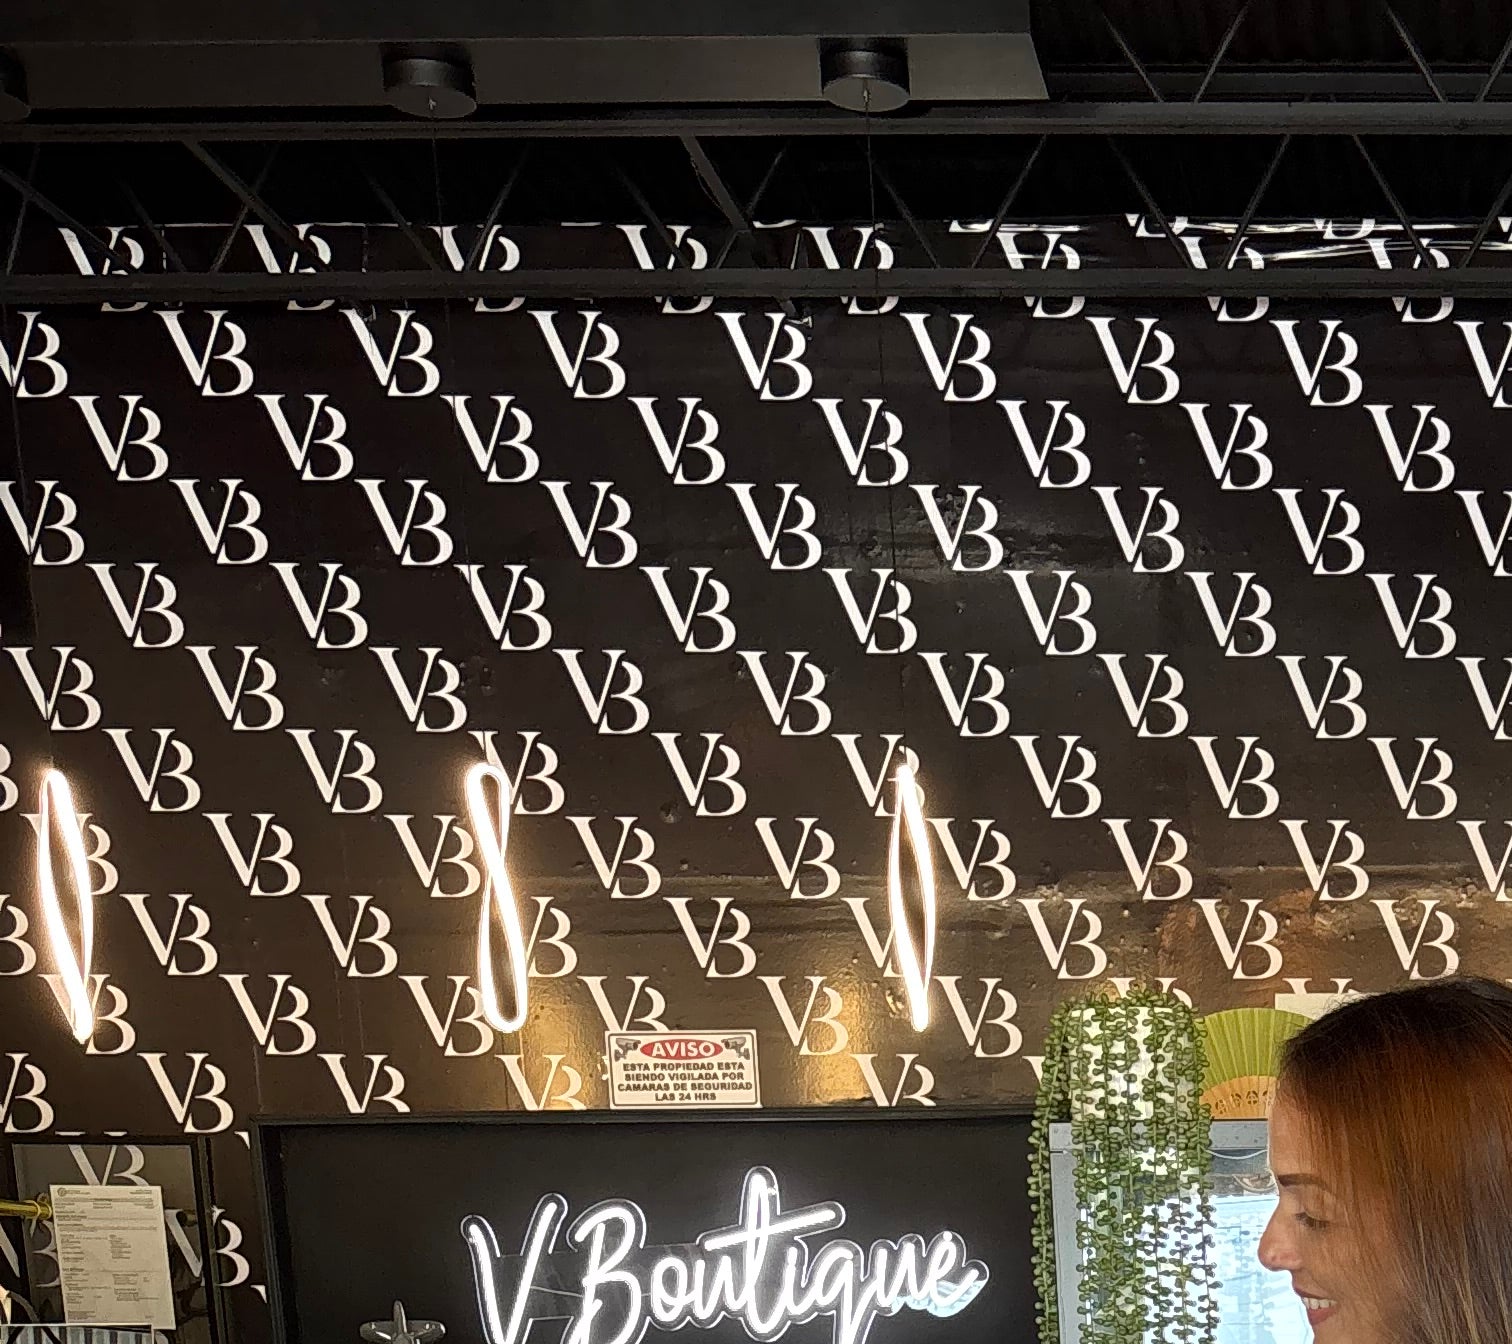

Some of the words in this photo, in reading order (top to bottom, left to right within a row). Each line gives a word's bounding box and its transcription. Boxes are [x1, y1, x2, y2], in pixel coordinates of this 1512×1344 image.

[157, 311, 253, 396] VB
[341, 309, 439, 396] VB
[528, 311, 625, 398] VB
[715, 313, 812, 400] VB
[900, 313, 996, 401] VB
[1086, 317, 1179, 403] VB
[1270, 320, 1362, 406] VB
[70, 395, 168, 481] VB
[255, 395, 353, 480] VB
[441, 395, 539, 482] VB
[628, 397, 725, 484] VB
[813, 399, 908, 486] VB
[996, 400, 1091, 487] VB
[1180, 403, 1272, 489] VB
[1364, 405, 1454, 491] VB
[0, 481, 84, 565] VB
[170, 479, 268, 564] VB
[355, 479, 453, 565] VB
[540, 481, 637, 567] VB
[726, 483, 821, 569] VB
[909, 485, 1003, 571] VB
[1091, 487, 1184, 572] VB
[1273, 489, 1364, 574] VB
[86, 563, 184, 647] VB
[269, 563, 367, 648] VB
[454, 565, 551, 650] VB
[640, 567, 736, 652] VB
[822, 568, 917, 653] VB
[1003, 570, 1096, 655] VB
[1184, 572, 1276, 656] VB
[1365, 574, 1456, 658] VB
[7, 646, 102, 731] VB
[185, 646, 283, 730] VB
[369, 647, 467, 732] VB
[553, 649, 649, 734] VB
[736, 651, 831, 735] VB
[918, 652, 1009, 736] VB
[1096, 654, 1188, 737] VB
[1276, 656, 1366, 738] VB
[103, 729, 200, 811] VB
[286, 729, 382, 813] VB
[652, 733, 746, 816] VB
[1010, 736, 1101, 818] VB
[1188, 736, 1279, 818] VB
[1368, 738, 1457, 819] VB
[203, 813, 300, 896] VB
[383, 814, 481, 898] VB
[566, 816, 661, 898] VB
[755, 818, 840, 899] VB
[925, 817, 1016, 901] VB
[1102, 819, 1192, 900] VB
[1279, 820, 1369, 901] VB
[120, 894, 217, 975] VB
[302, 895, 397, 977] VB
[663, 897, 756, 977] VB
[1015, 898, 1108, 980] VB
[1193, 899, 1283, 979] VB
[1369, 898, 1460, 981] VB
[219, 974, 316, 1055] VB
[398, 975, 494, 1057] VB
[651, 1041, 716, 1057] AVISO
[756, 975, 849, 1056] VB
[933, 975, 1023, 1058] VB
[137, 1053, 233, 1133] VB
[617, 1083, 670, 1092] CAMARAS
[673, 1083, 688, 1091] DE
[691, 1082, 752, 1091] SEGURIDAD
[622, 1063, 650, 1072] ESTA
[653, 1062, 714, 1072] PROPIEDAD
[717, 1062, 745, 1071] ESTA
[624, 1073, 665, 1082] SIENDO
[668, 1072, 719, 1081] VIGILADA
[722, 1072, 744, 1080] POR
[655, 1093, 675, 1101] LAS
[679, 1093, 691, 1101] 24
[694, 1093, 717, 1101] HRS
